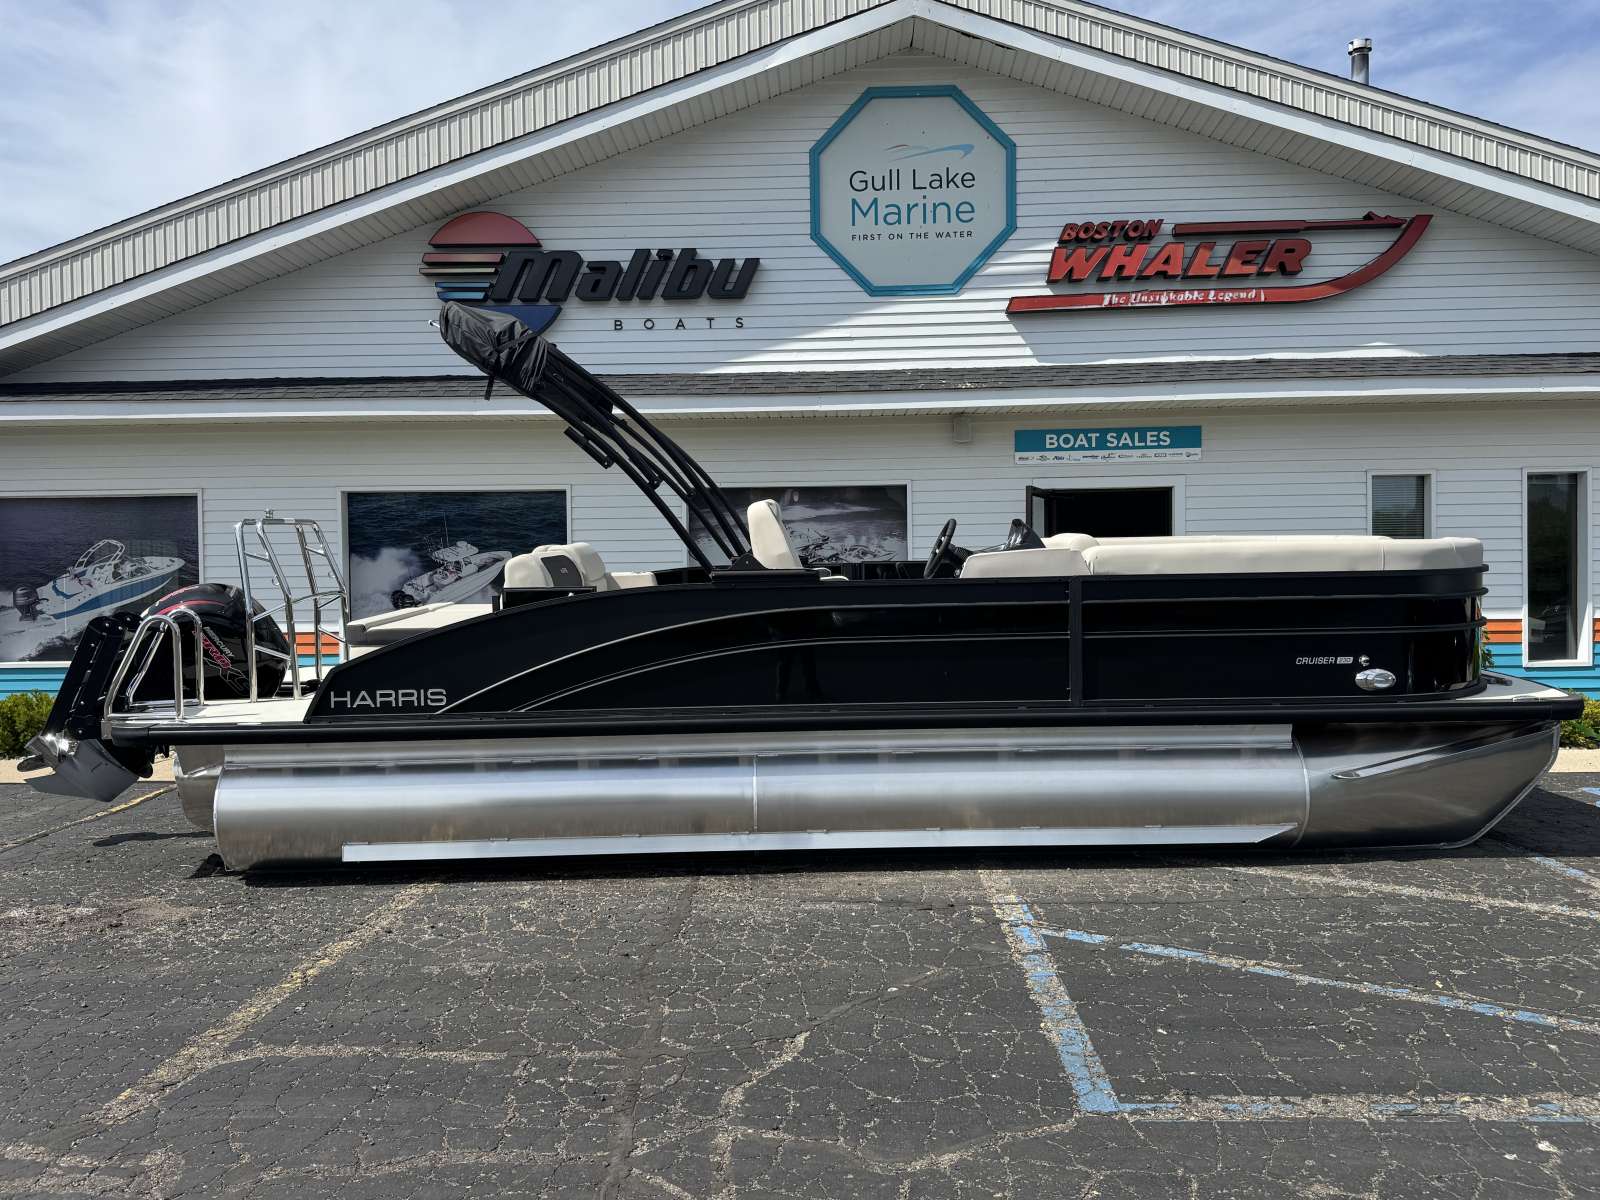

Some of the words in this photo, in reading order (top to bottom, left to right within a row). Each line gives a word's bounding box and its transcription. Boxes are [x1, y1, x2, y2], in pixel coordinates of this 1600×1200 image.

[849, 168, 901, 192] Gull
[912, 167, 976, 190] Lake
[851, 195, 976, 227] Marine
[851, 233, 882, 241] FIRST
[935, 230, 973, 239] WATER
[1057, 218, 1165, 244] BOSTON
[1047, 238, 1313, 284] WHALER
[489, 248, 761, 304] Malibu
[1102, 293, 1127, 306] The
[1208, 288, 1256, 302] Legend
[613, 317, 744, 331] BOATS
[1045, 432, 1100, 449] BOAT
[1106, 431, 1171, 447] SALES
[1295, 656, 1336, 665] CRUISER
[330, 688, 447, 708] HARRIS
